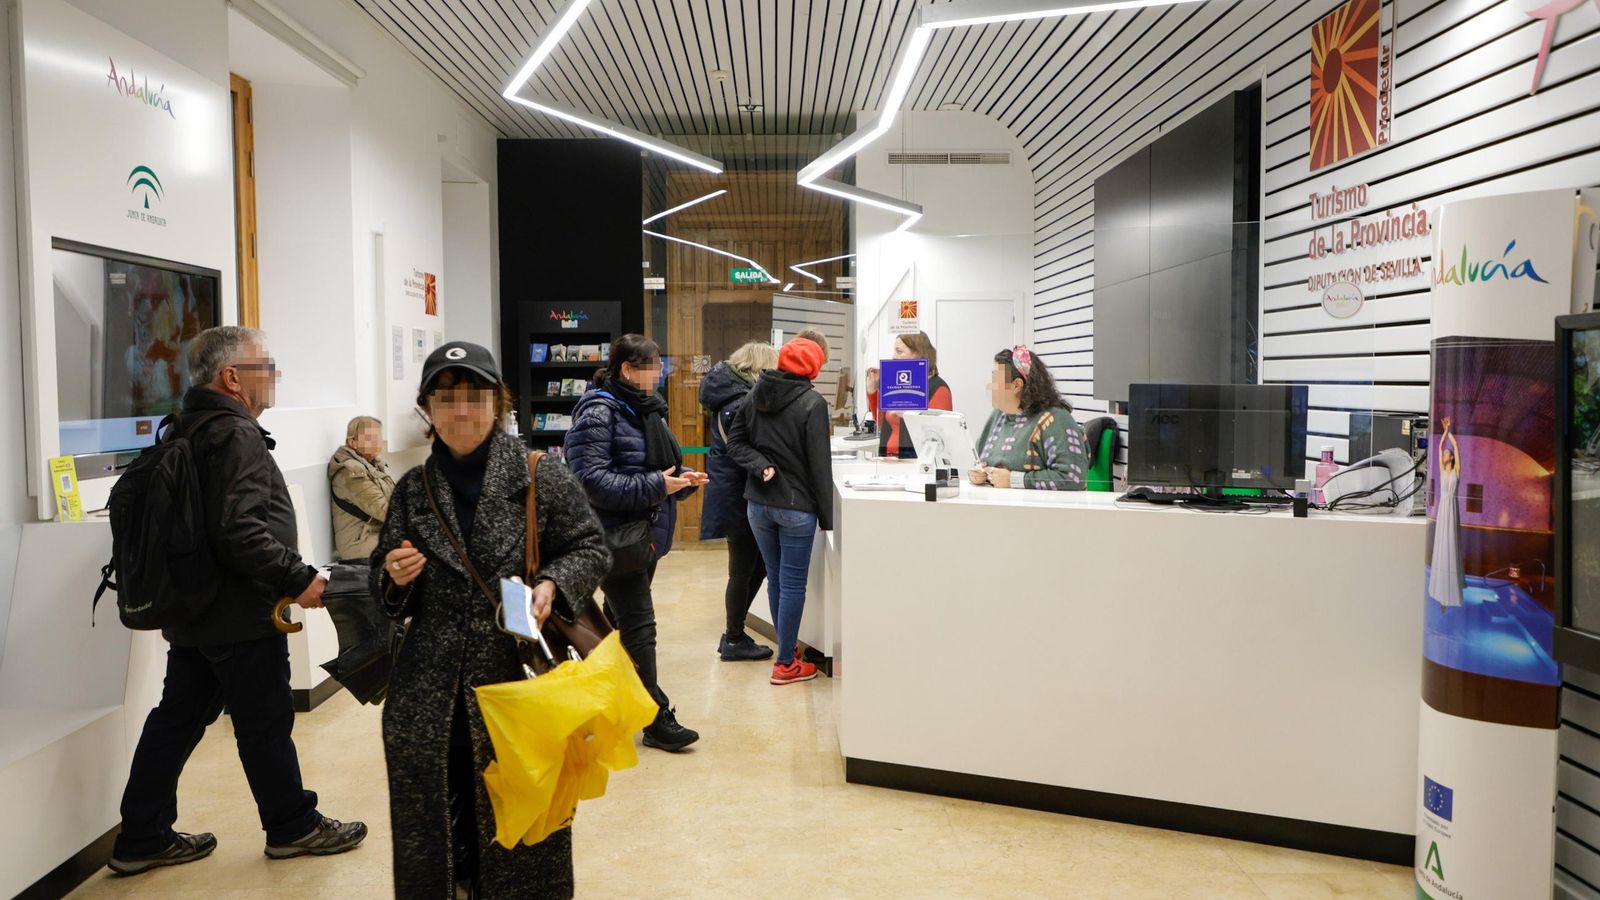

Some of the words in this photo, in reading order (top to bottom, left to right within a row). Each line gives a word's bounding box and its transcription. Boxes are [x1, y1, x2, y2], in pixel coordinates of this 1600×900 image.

[106, 56, 176, 120] Andalucía
[1378, 45, 1390, 145] Prodetur
[1309, 183, 1368, 220] Turismo
[1309, 230, 1326, 259] de
[1332, 224, 1345, 254] la
[1351, 202, 1429, 249] Provincia
[735, 271, 763, 280] SALIDA
[1365, 264, 1378, 282] DE
[1380, 257, 1422, 281] SEVILLA
